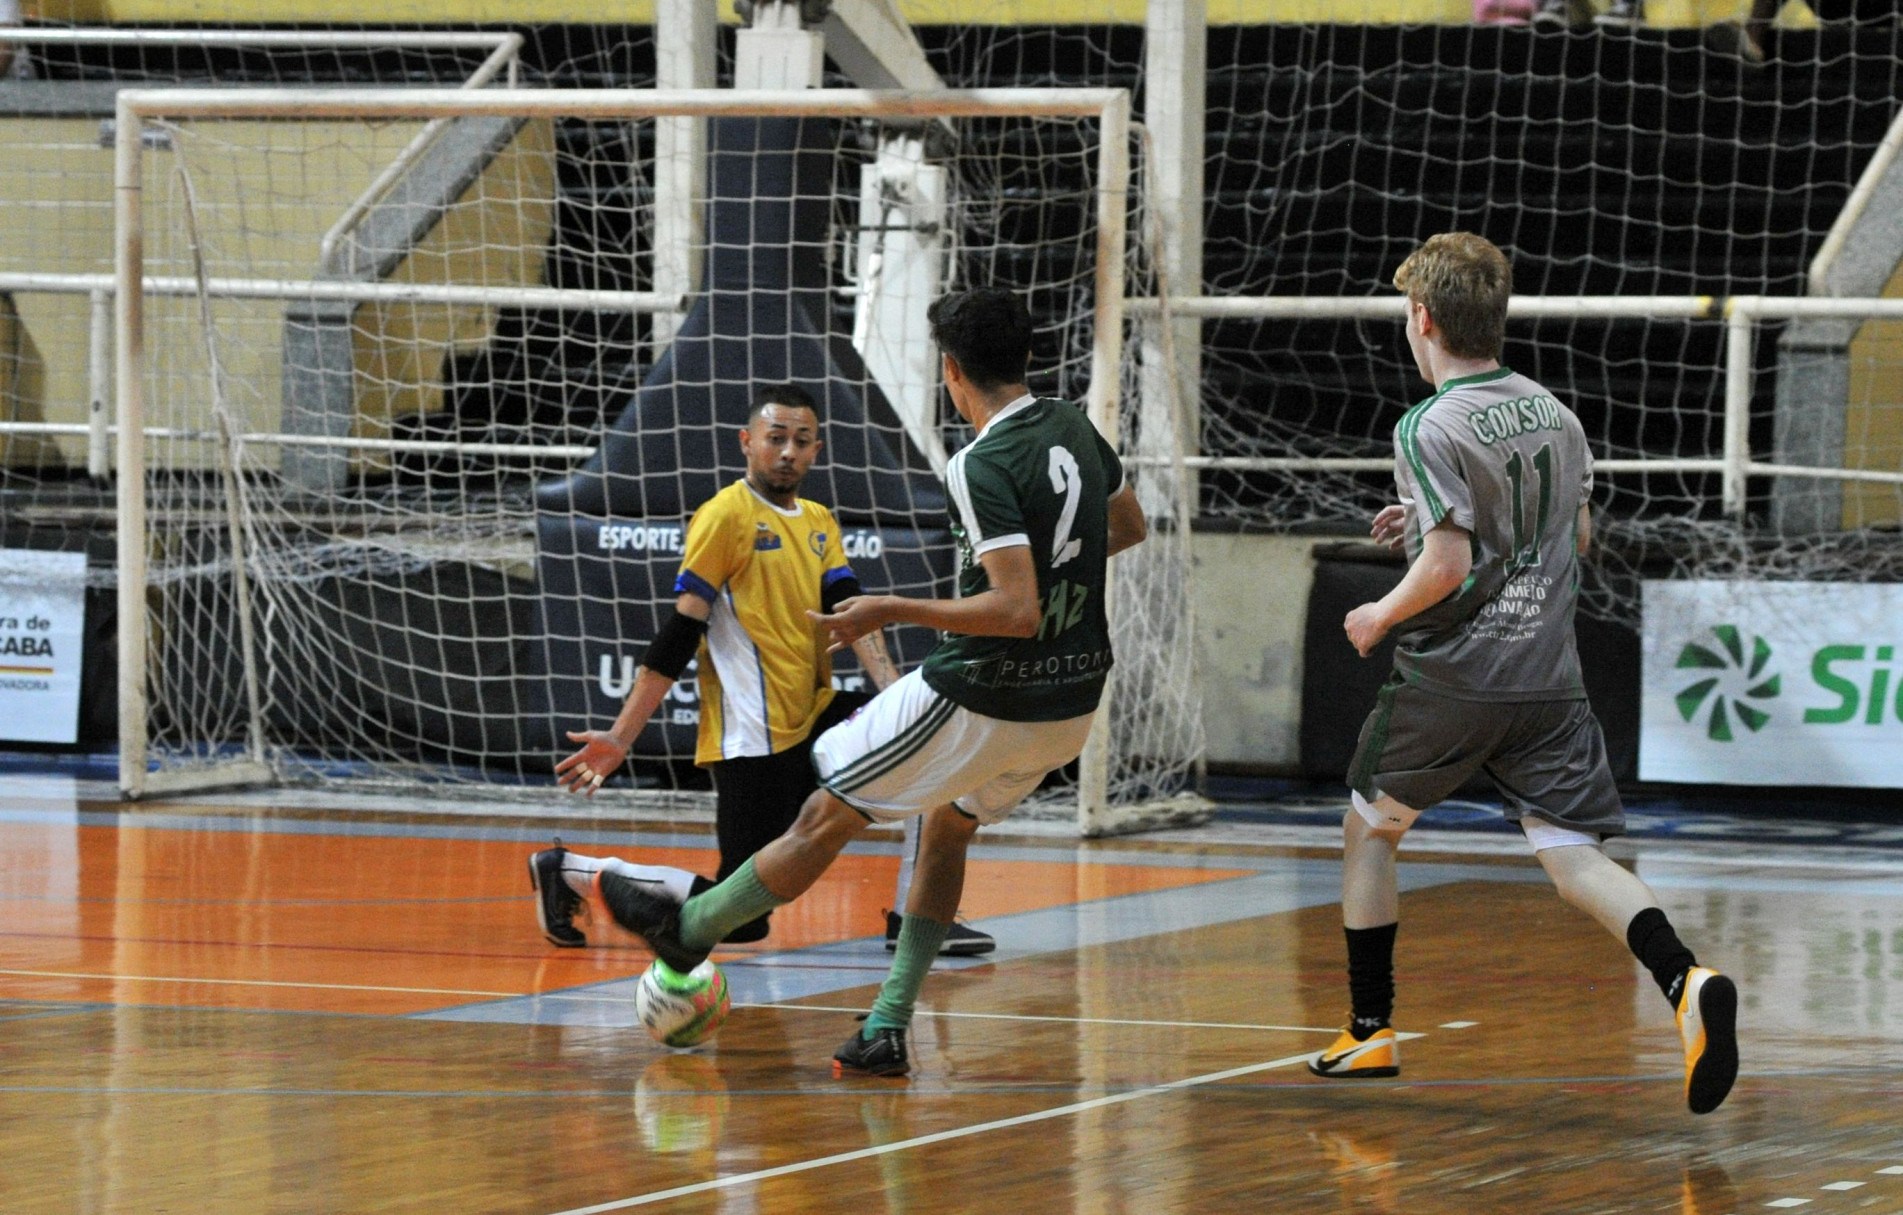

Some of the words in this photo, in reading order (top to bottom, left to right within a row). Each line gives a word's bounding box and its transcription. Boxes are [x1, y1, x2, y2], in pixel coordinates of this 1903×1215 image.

[1469, 395, 1562, 445] CONSOR
[1048, 445, 1082, 569] 2
[1504, 441, 1551, 577] 11
[26, 614, 50, 631] de
